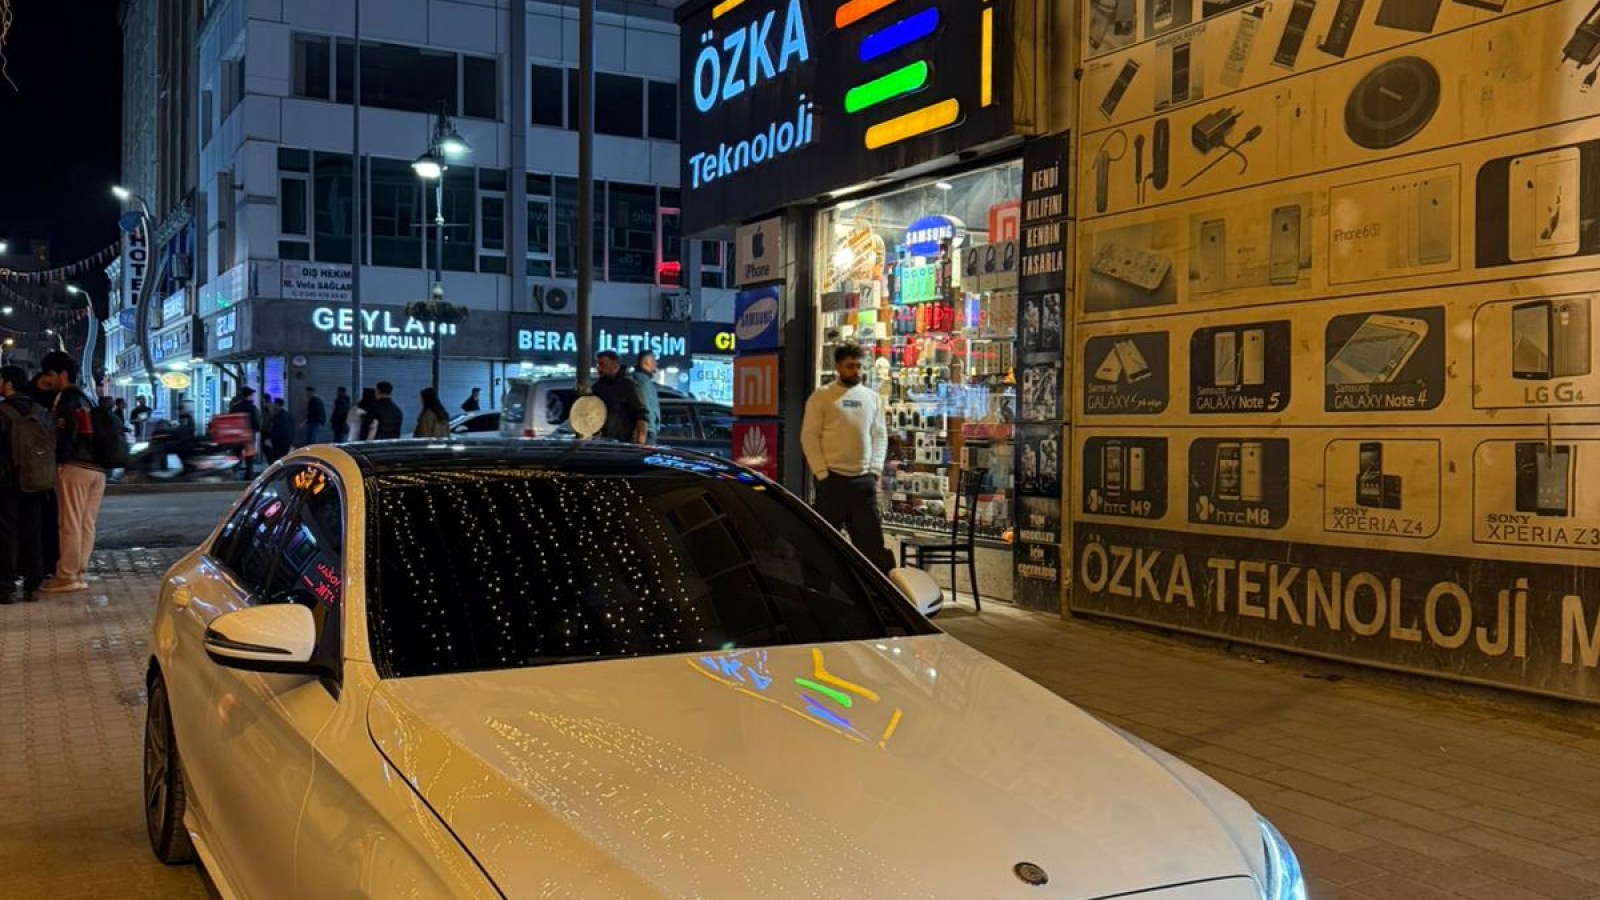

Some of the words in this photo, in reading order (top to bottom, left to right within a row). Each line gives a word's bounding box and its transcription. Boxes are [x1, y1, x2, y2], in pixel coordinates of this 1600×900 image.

[693, 0, 809, 113] ÖZKA
[906, 225, 953, 247] SAMSUNG
[1022, 249, 1064, 277] TASARLA
[518, 329, 578, 352] BERA
[600, 328, 686, 360] İLETİŞİM
[1087, 394, 1130, 409] GALAXY
[1196, 395, 1238, 411] GALAXY
[1240, 395, 1265, 409] Note
[1267, 391, 1281, 411] 5
[1334, 394, 1383, 409] GALAXY
[1385, 394, 1416, 408] Note
[1418, 388, 1428, 407] 4
[1524, 386, 1549, 404] LG
[1131, 499, 1152, 516] M9
[1246, 507, 1270, 525] M8
[1332, 505, 1369, 516] SONY
[1332, 514, 1399, 533] XPERIA
[1402, 518, 1423, 534] Z4
[1487, 512, 1531, 525] SONY
[1487, 524, 1569, 544] XPERIA
[1080, 533, 1195, 607] ÖZKA
[1207, 555, 1528, 659] TEKNOLOJİ
